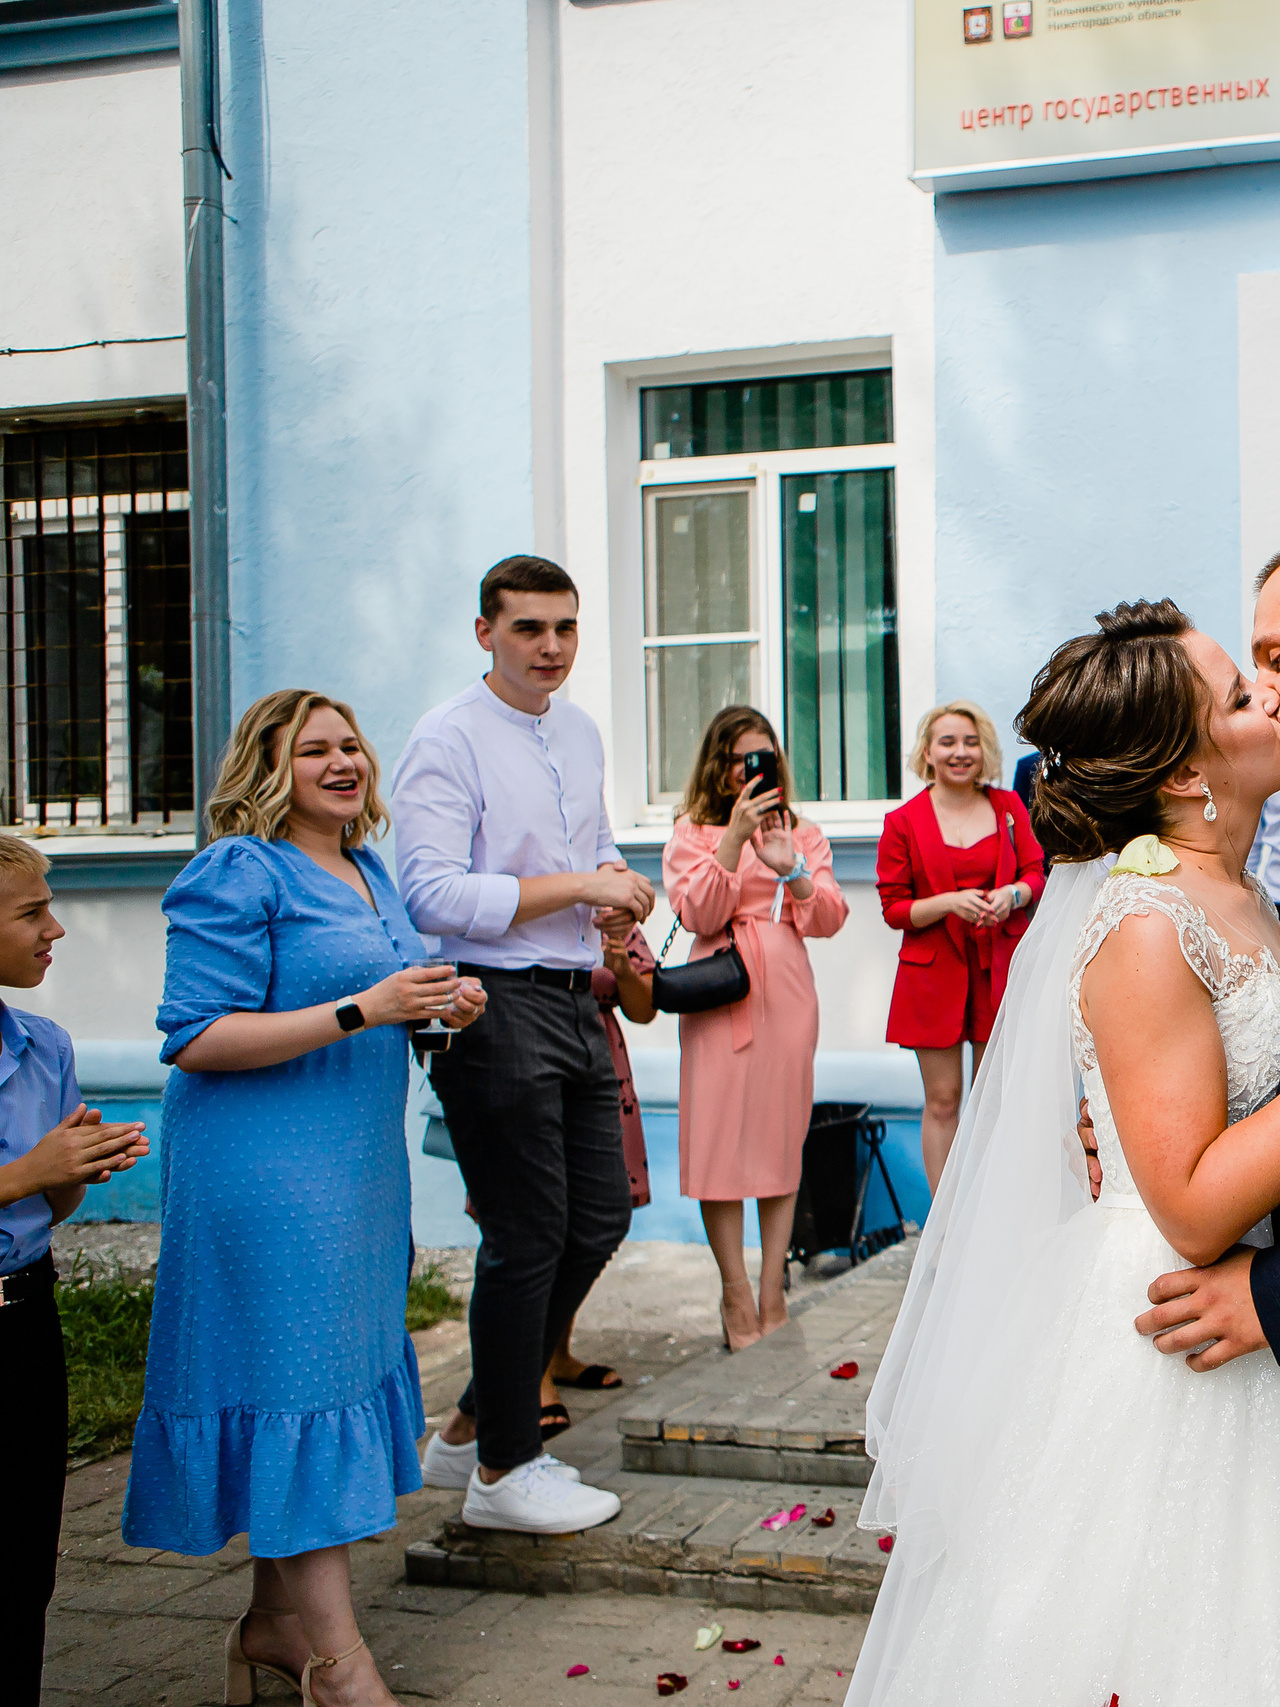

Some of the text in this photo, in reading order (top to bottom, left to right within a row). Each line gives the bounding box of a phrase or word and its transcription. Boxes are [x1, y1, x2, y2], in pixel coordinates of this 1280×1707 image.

[1048, 2, 1125, 17] Пильнинского
[1048, 8, 1182, 31] Нижегородской области
[961, 101, 1033, 130] центр
[1043, 76, 1269, 123] государственных
